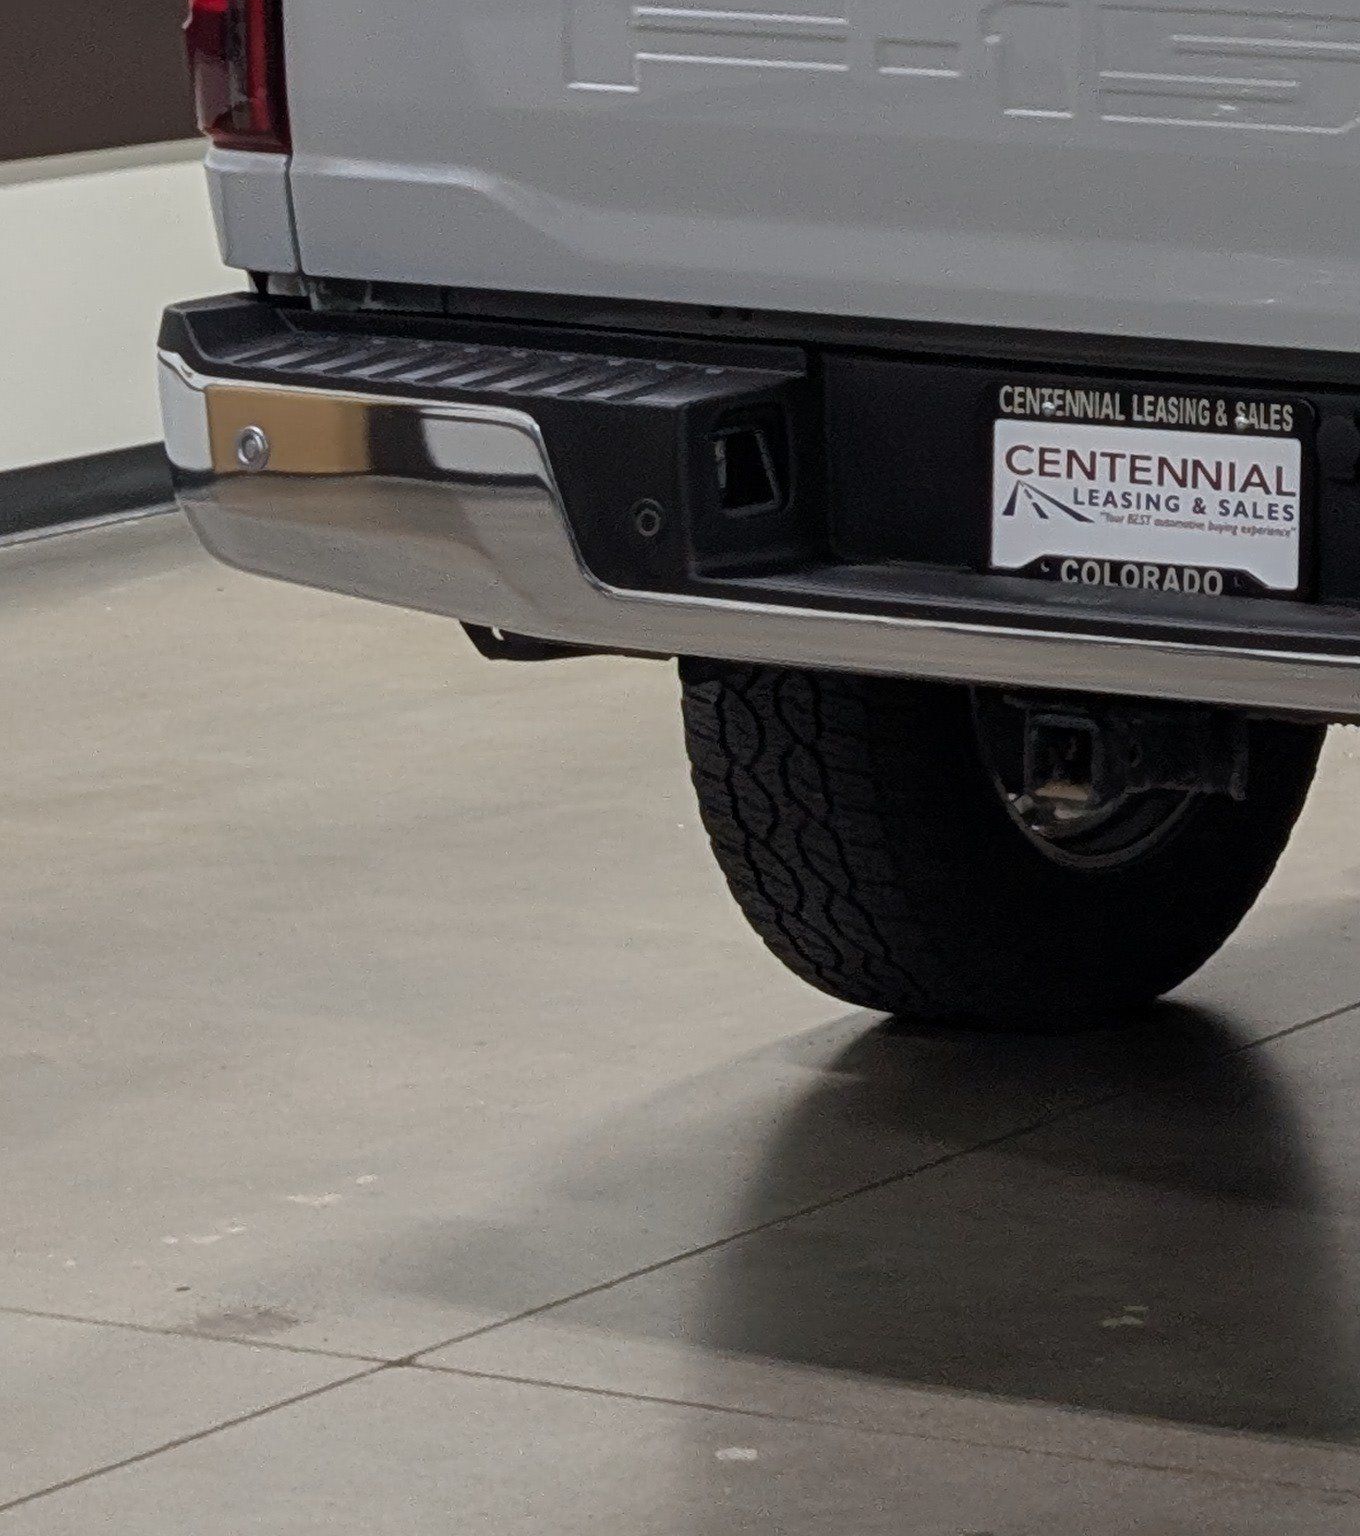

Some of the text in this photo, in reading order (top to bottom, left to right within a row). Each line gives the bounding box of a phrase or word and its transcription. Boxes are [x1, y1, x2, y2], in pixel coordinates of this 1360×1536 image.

[1000, 385, 1293, 431] CENTENNIAL LEASING & SALES
[1005, 444, 1296, 497] CENTENNIAL
[1074, 487, 1295, 522] LEASING & SALES
[1061, 560, 1223, 596] COLORADO
